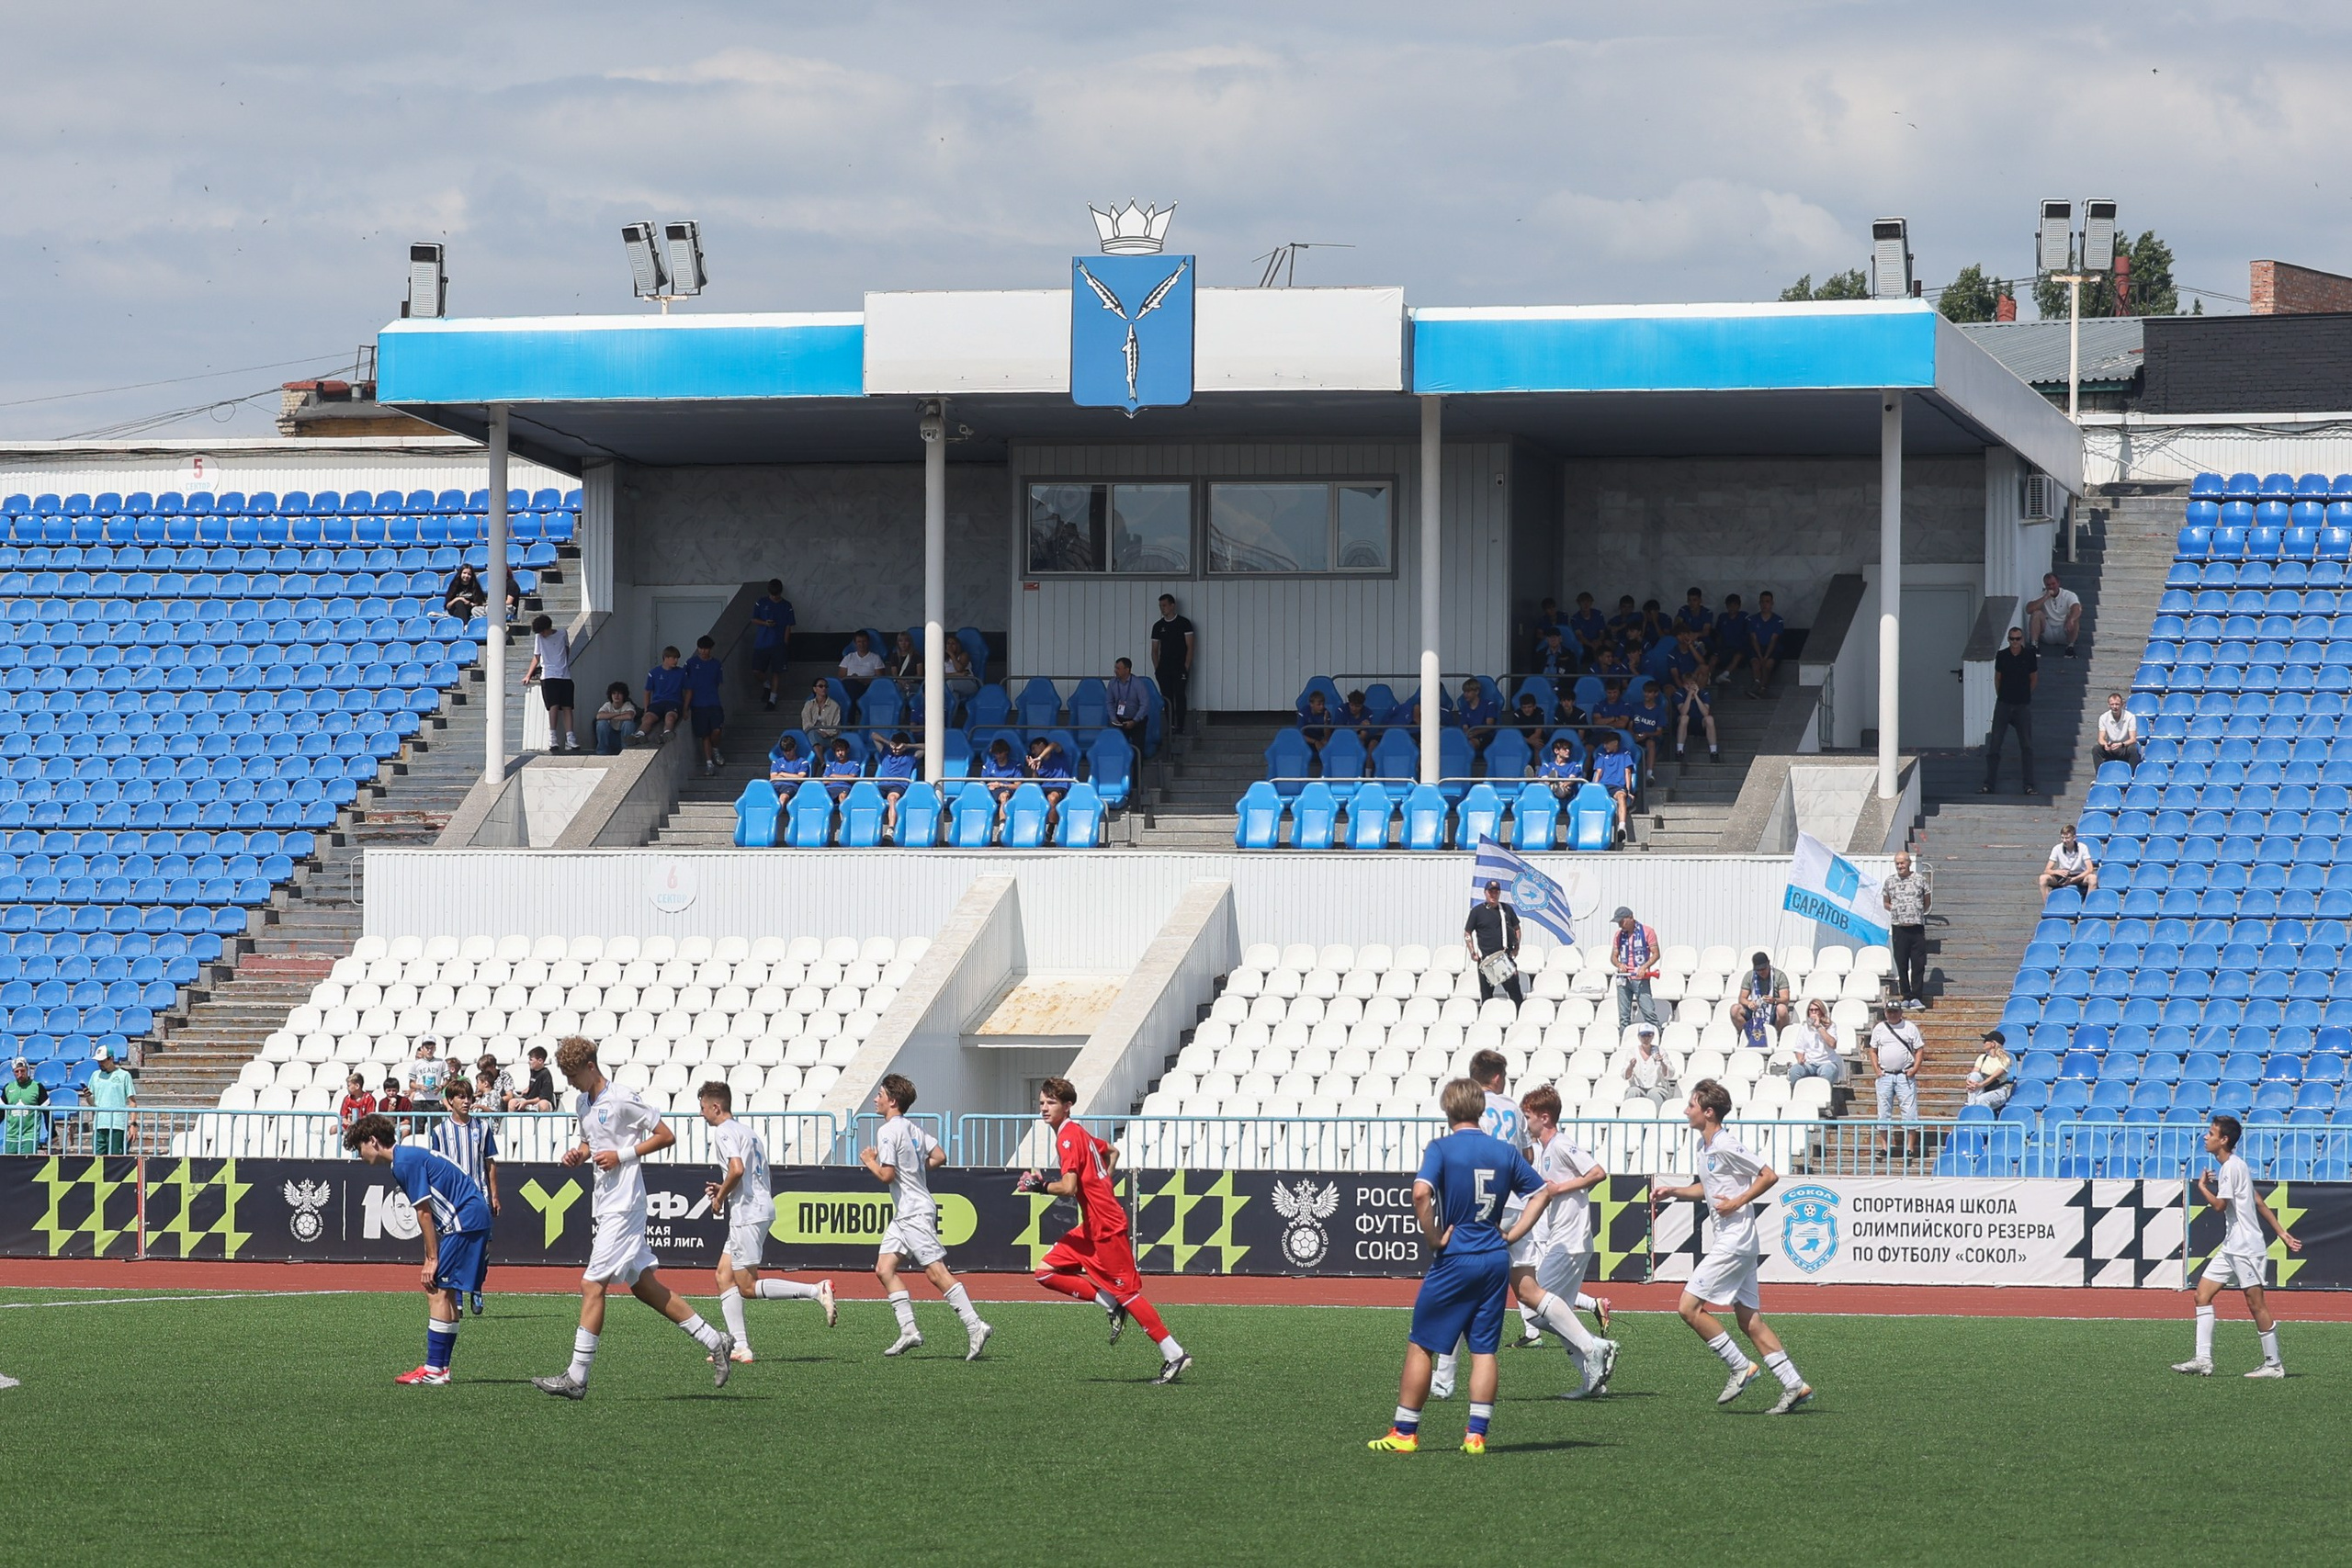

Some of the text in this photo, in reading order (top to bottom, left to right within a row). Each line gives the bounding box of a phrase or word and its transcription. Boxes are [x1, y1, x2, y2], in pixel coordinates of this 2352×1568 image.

[194, 458, 203, 479] 5
[667, 864, 678, 889] 6
[1568, 872, 1580, 897] 7
[657, 893, 688, 904] СЕКТОР
[1792, 892, 1849, 931] САРАТОВ
[1486, 1107, 1517, 1142] 22
[1474, 1168, 1497, 1223] 5
[1788, 1189, 1833, 1200] СОКОЛ
[1852, 1198, 2018, 1214] СПОРТИВНАЯ ШКОЛА
[798, 1202, 944, 1235] ПРИВОЛЕ
[1852, 1219, 2056, 1239] ОЛИМПИЙСКОГО РЕЗЕРВА
[673, 1237, 705, 1248] ЛИГА
[1355, 1241, 1419, 1260] СОЮЗ
[1852, 1246, 2027, 1263] ПО ФУТБОЛУ «СОКОЛ»
